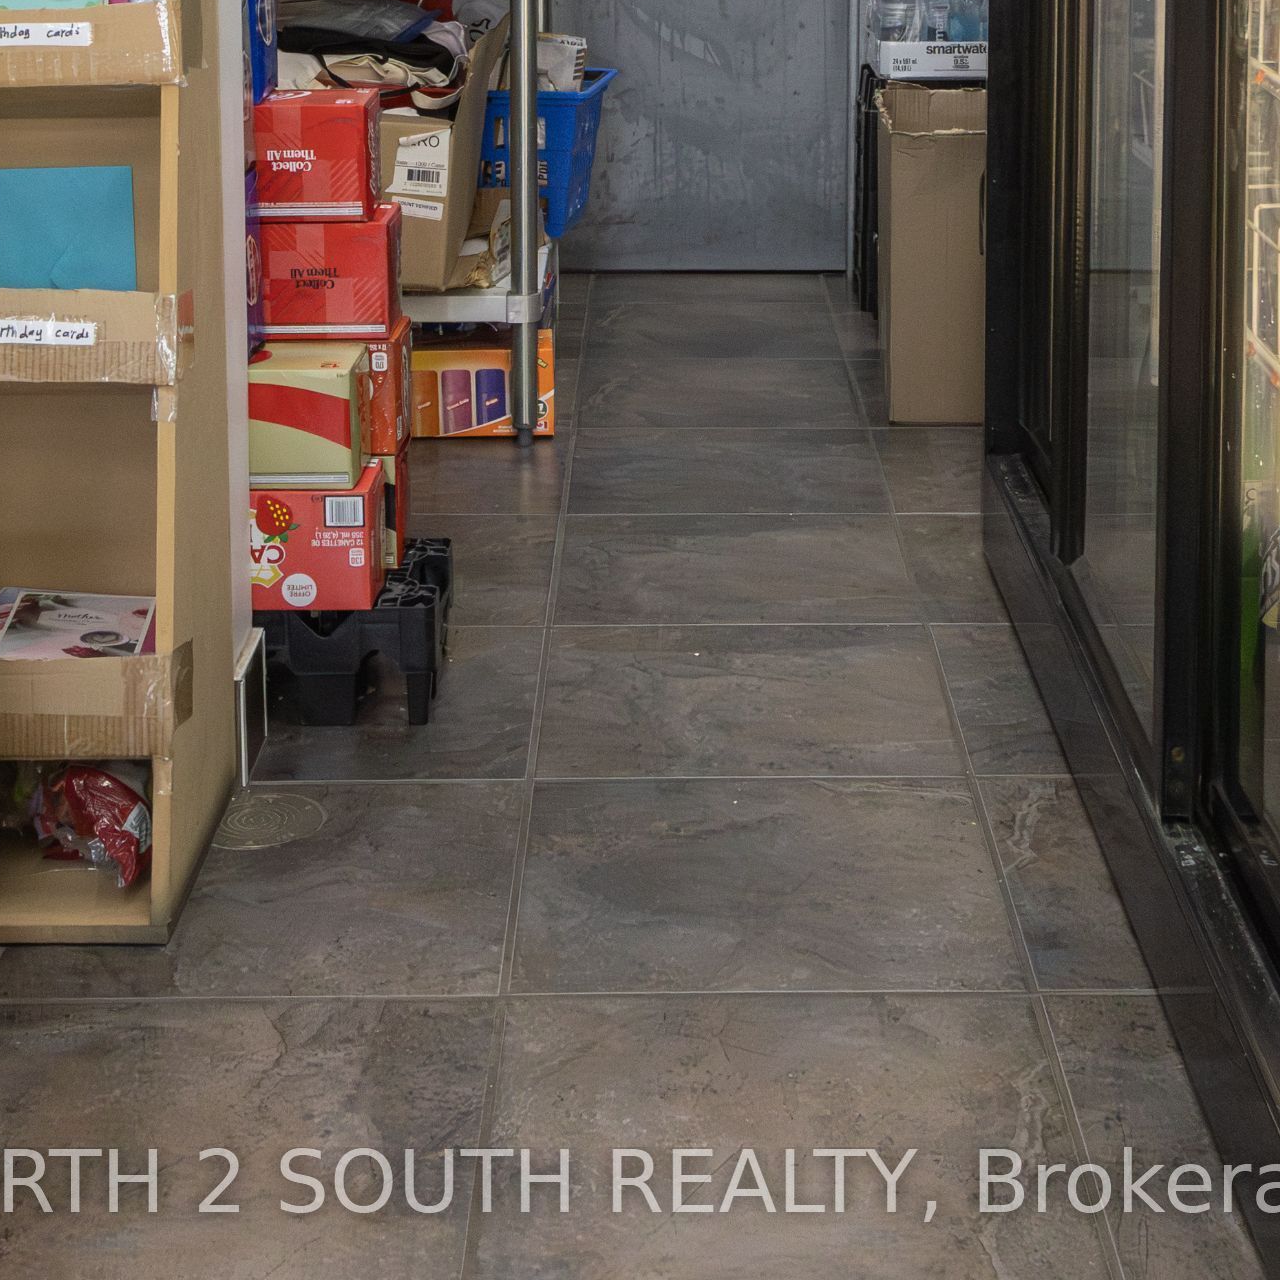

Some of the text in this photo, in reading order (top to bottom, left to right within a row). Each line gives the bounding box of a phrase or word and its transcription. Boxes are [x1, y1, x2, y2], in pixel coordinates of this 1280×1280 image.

[926, 43, 987, 56] smartwat
[266, 149, 317, 161] Them All
[271, 160, 312, 172] Collect
[290, 266, 340, 279] Them All
[295, 277, 336, 290] Collect
[55, 323, 90, 340] cards
[321, 538, 356, 547] CANETTES
[286, 583, 314, 592] LIMITÉE
[289, 590, 312, 598] OFFRE
